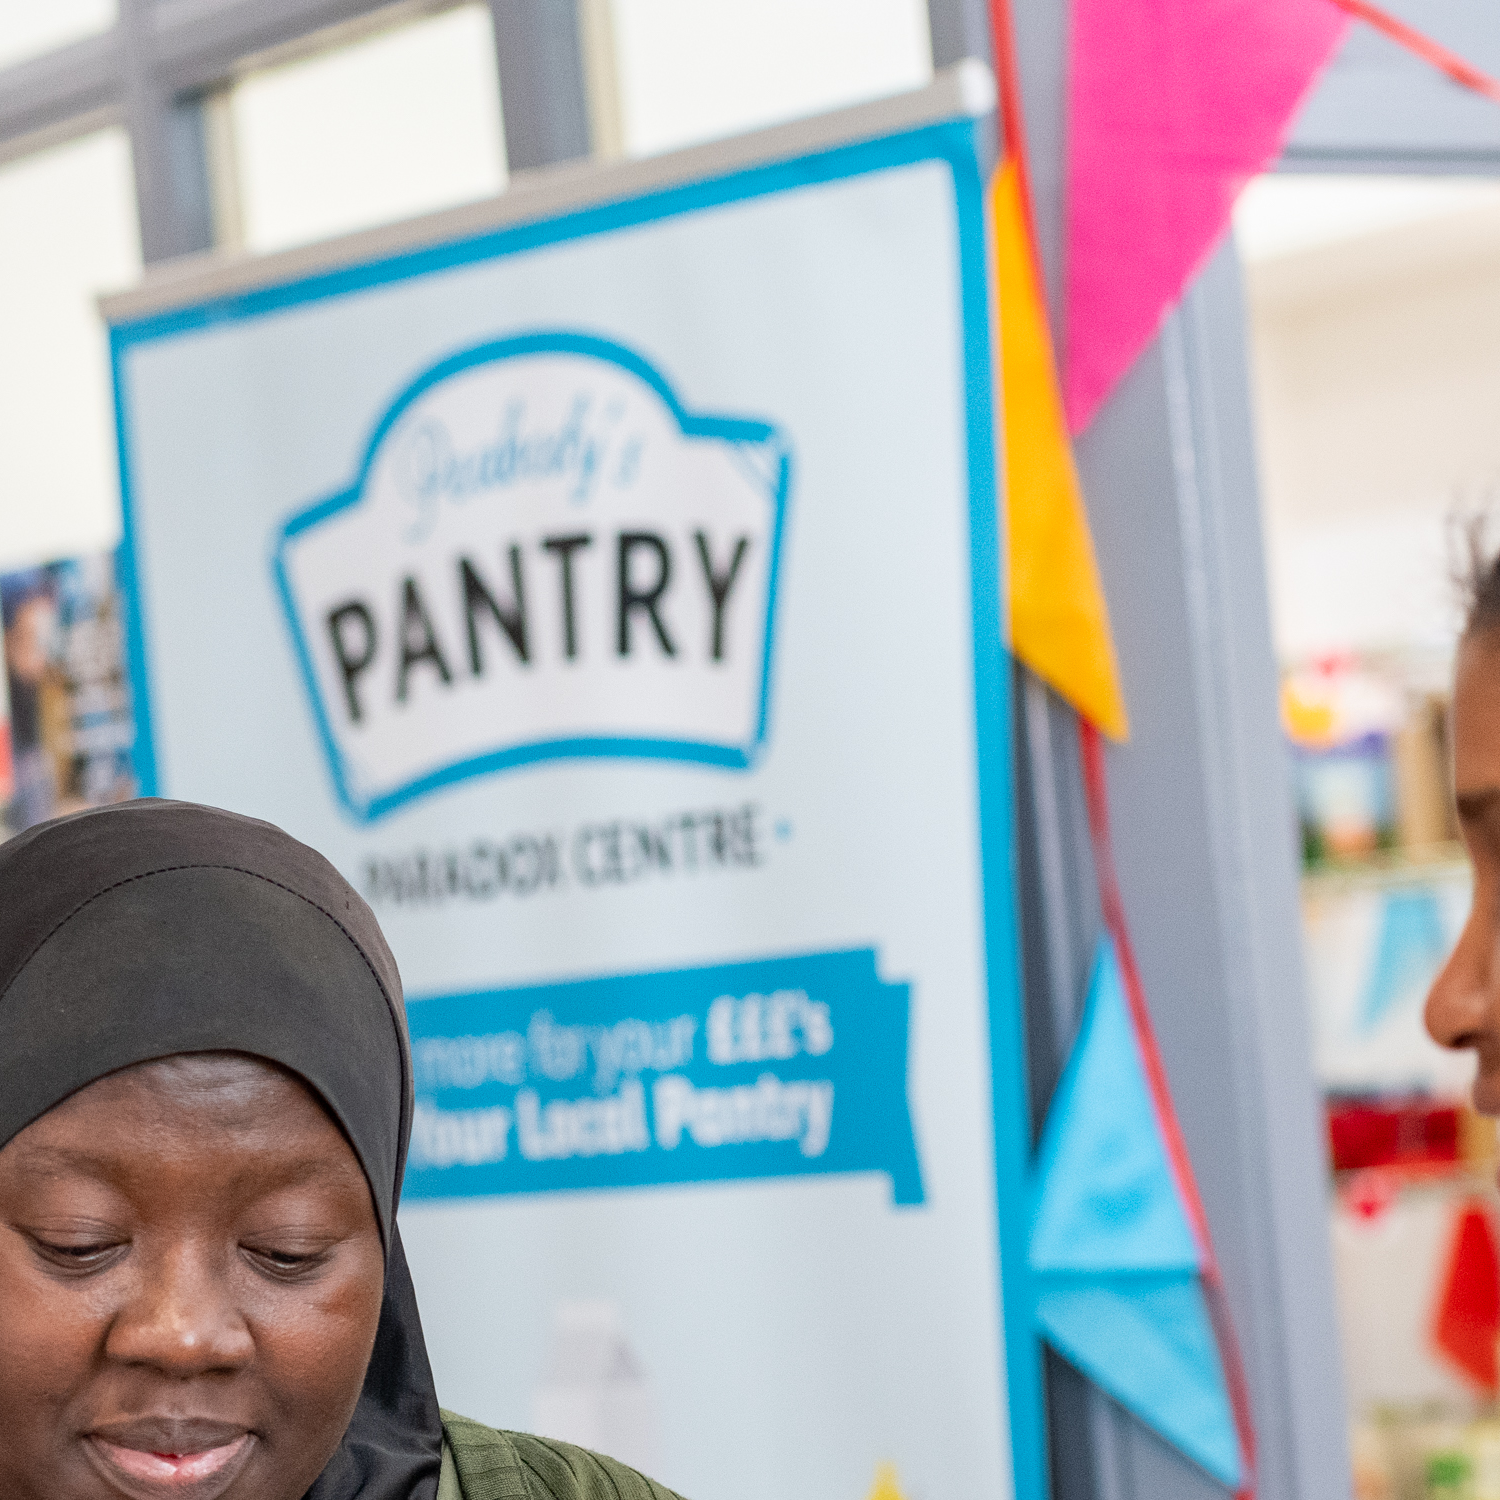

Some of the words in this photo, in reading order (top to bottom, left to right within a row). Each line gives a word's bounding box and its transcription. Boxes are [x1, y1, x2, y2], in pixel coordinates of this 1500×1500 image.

[327, 527, 752, 724] PANTRY
[360, 832, 562, 908] PARADOX
[574, 804, 765, 889] CENTRE
[413, 1033, 524, 1086] more
[529, 1008, 586, 1080] for
[585, 1015, 697, 1095] your
[514, 1074, 649, 1162] Local
[654, 1070, 838, 1159] Pantry
